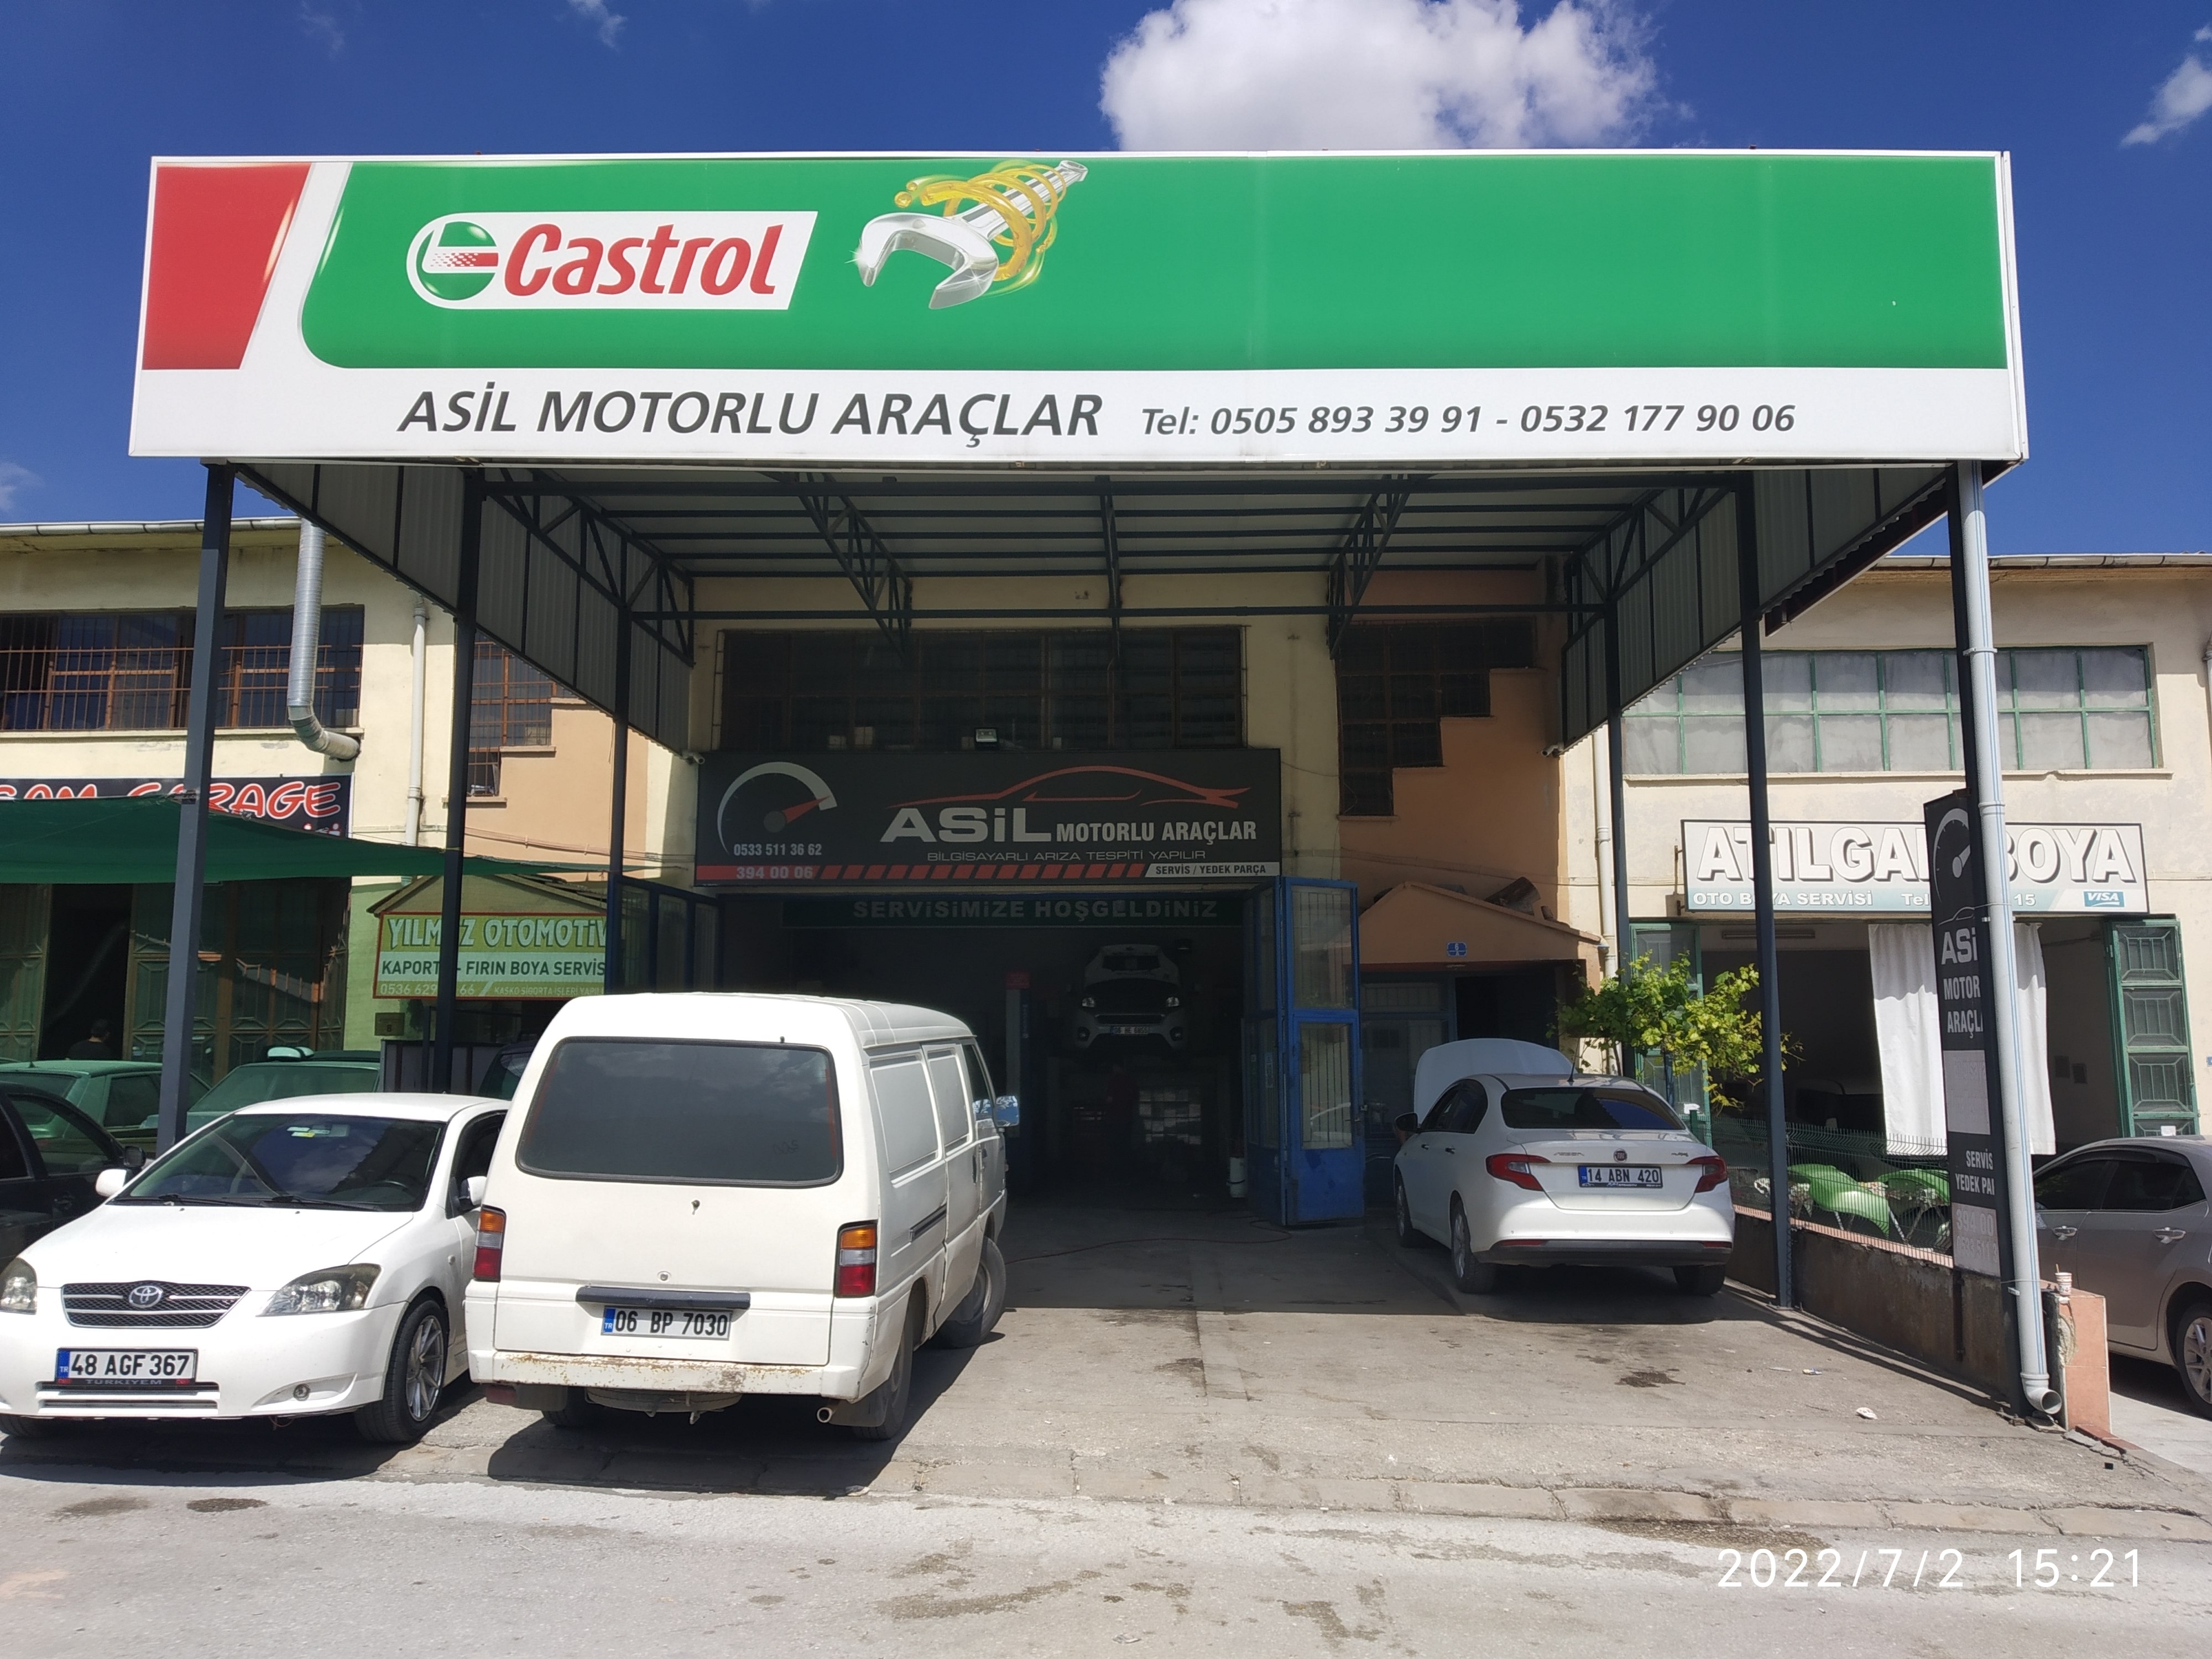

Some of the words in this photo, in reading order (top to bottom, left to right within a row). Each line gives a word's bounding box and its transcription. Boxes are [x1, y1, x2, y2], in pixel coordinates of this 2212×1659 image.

[504, 223, 783, 296] Castrol
[397, 381, 517, 432] ASİL
[536, 390, 819, 435] MOTORLU
[830, 393, 1103, 448] ARAÇLAR
[1141, 406, 1199, 435] Tel:
[1210, 406, 1298, 435] 0505
[1308, 405, 1374, 434] 893
[1384, 405, 1428, 433] 39
[1441, 405, 1481, 433] 91
[1520, 405, 1608, 432] 0532
[1624, 405, 1684, 431] 177
[1696, 404, 1740, 432] 90
[1752, 404, 1796, 431] 06
[1056, 822, 1154, 842] MOTORLU
[1161, 821, 1256, 845] ARAÇLAR
[733, 843, 762, 856] 0533
[765, 843, 786, 856] 511
[790, 843, 804, 856] 36
[807, 843, 822, 856] 62
[1034, 852, 1081, 861] ARIZA
[1149, 850, 1206, 859] YAPILIR
[736, 866, 765, 879] 394
[770, 866, 789, 879] 00
[794, 866, 813, 879] 06
[1199, 865, 1231, 874] YEDEK
[1234, 864, 1266, 875] PARÇA
[1693, 892, 1733, 905] OTO
[1740, 892, 1791, 905] BYA
[2086, 892, 2119, 901] VISA
[388, 919, 476, 950] YILMZ
[382, 960, 440, 975] KAPORT
[466, 961, 506, 975] FIRIN
[510, 961, 550, 975] BOYA
[553, 958, 606, 976] SERVİS
[379, 983, 410, 995] 0536
[1943, 975, 1981, 1000] MOTOR
[1947, 1009, 1984, 1039] ARAÇL
[1588, 1168, 1601, 1182] 14
[1609, 1168, 1630, 1182] ABN
[1637, 1169, 1659, 1183] 420
[1955, 1173, 1980, 1193] YEDEK
[615, 1310, 638, 1333] 06
[650, 1311, 674, 1334] BP
[682, 1313, 728, 1337] 7030
[71, 1354, 97, 1375] 48
[104, 1354, 147, 1376] AGF
[149, 1354, 190, 1376] 367
